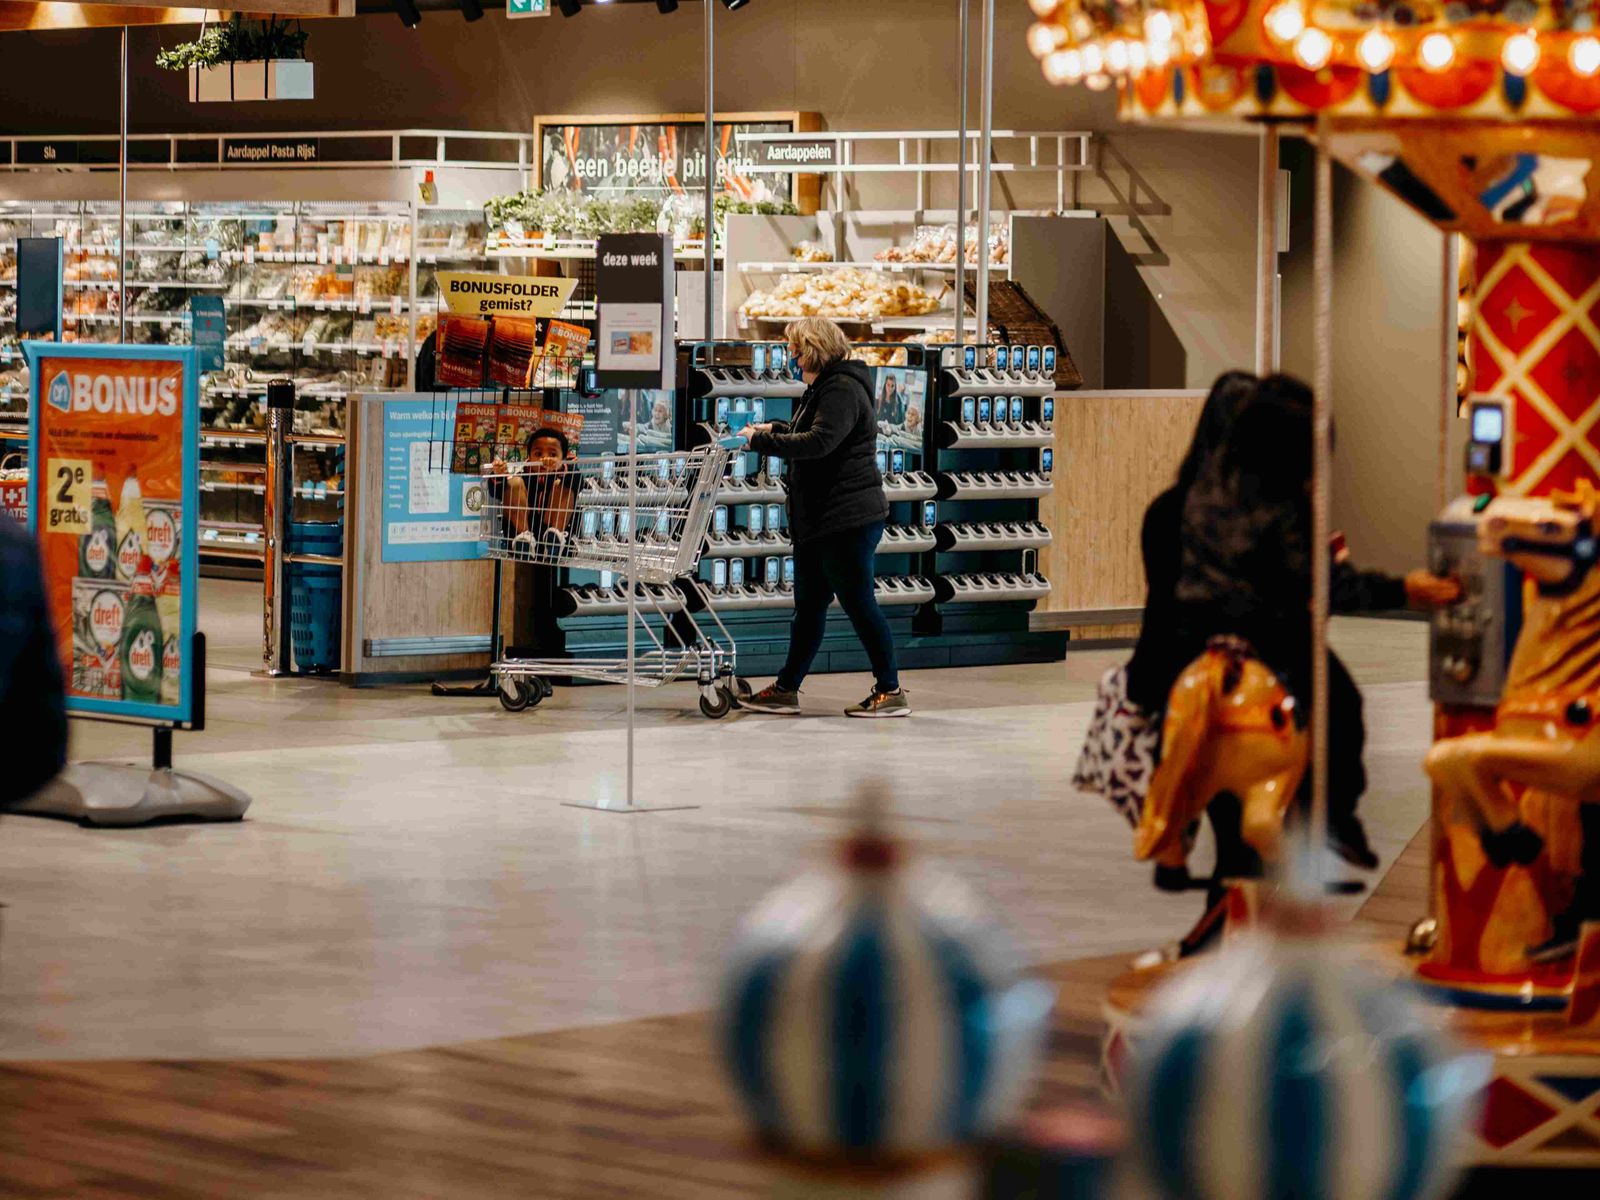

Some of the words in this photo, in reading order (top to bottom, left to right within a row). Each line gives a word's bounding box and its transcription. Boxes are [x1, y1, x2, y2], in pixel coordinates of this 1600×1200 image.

[43, 145, 56, 159] Sla
[227, 144, 270, 160] Aardappel
[271, 145, 295, 158] Pasta
[297, 144, 316, 160] Rijst
[767, 144, 832, 162] Aardappelen
[575, 158, 609, 177] een
[615, 152, 675, 184] beetje
[683, 152, 706, 182] pit
[603, 252, 628, 267] deze
[631, 252, 658, 267] week
[450, 280, 559, 298] BONUSFOLDER
[479, 298, 533, 311] gemist?
[558, 328, 588, 344] BONUS
[73, 374, 177, 416] BONUS
[389, 411, 411, 420] Warm
[412, 411, 439, 420] welkom
[464, 406, 496, 416] BONUS
[507, 407, 538, 418] BONUS
[551, 413, 582, 426] BONUS
[56, 466, 84, 503] 2e
[50, 505, 89, 526] gratis
[147, 521, 172, 543] dreft
[86, 546, 106, 561] dreft
[120, 549, 138, 565] dreft
[94, 603, 121, 625] dreft
[131, 649, 152, 667] dreft
